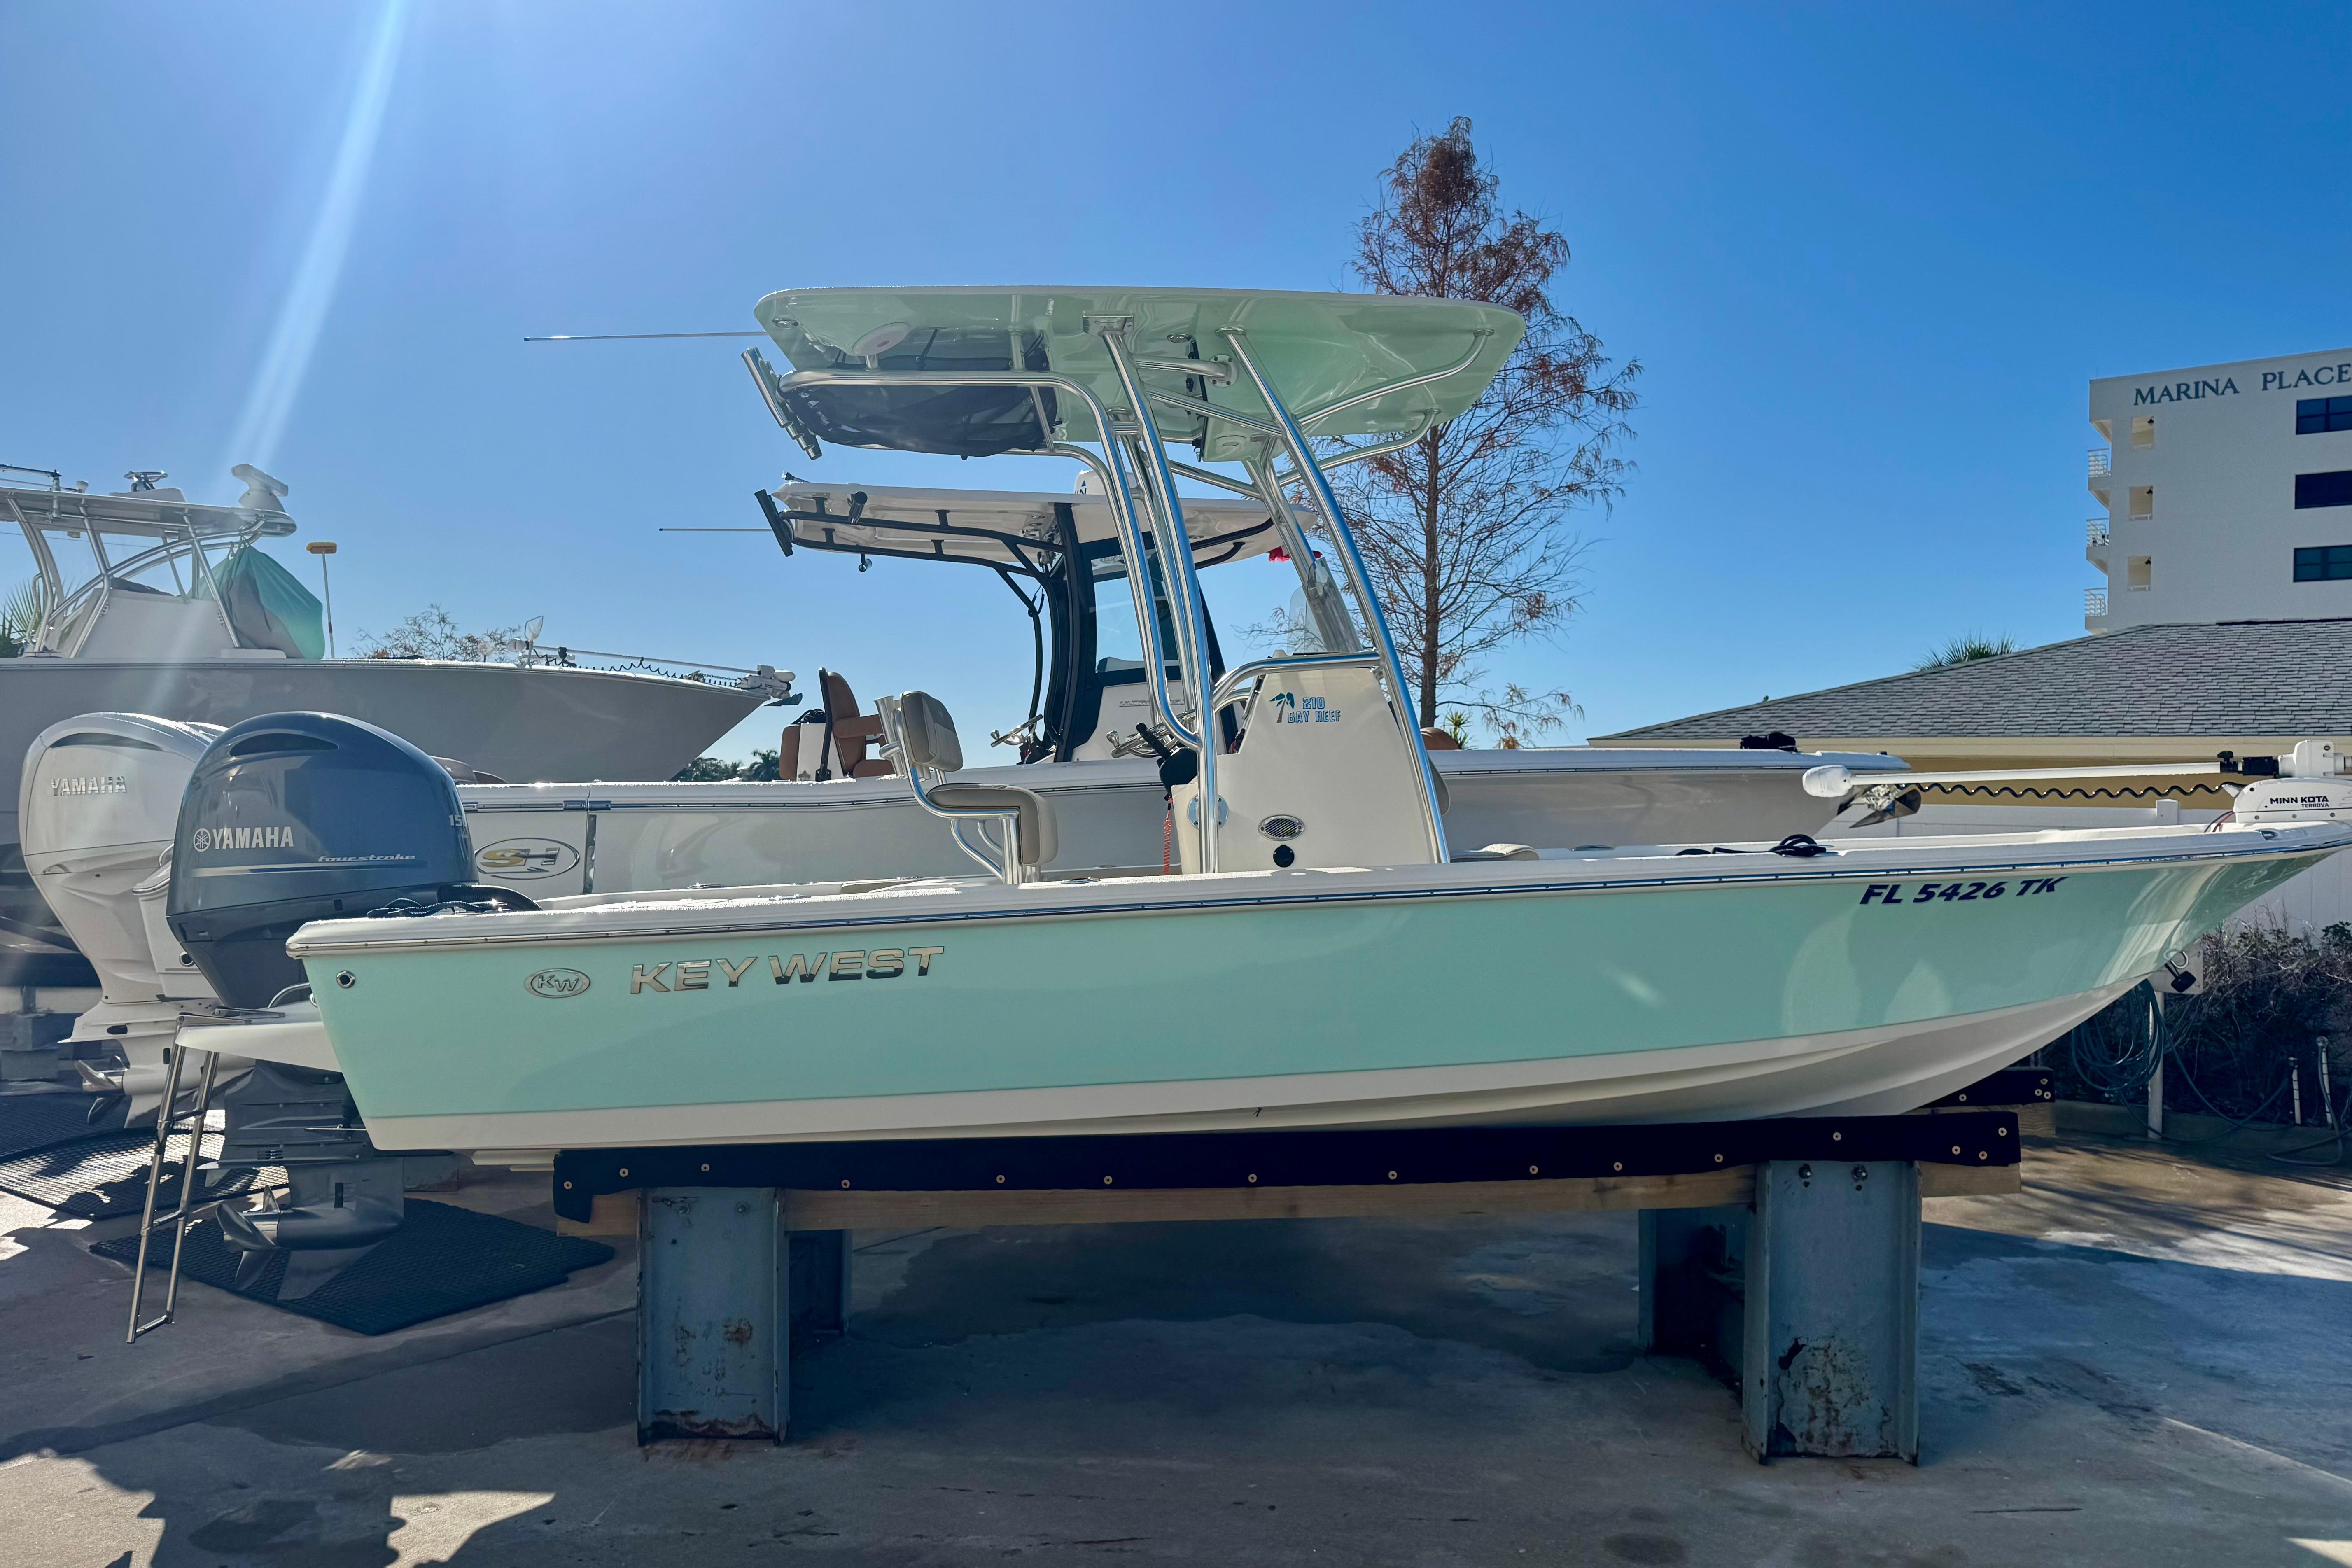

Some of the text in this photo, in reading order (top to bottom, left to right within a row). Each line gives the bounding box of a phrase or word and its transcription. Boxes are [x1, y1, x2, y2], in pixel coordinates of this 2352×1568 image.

[2133, 364, 2351, 406] MARINA PLACE
[1303, 697, 1325, 709] 210
[1288, 710, 1341, 723] BAY REEF
[51, 776, 127, 796] YAMAHA
[212, 826, 294, 849] YAMAHA
[1859, 877, 2069, 904] FL 5426 TK
[631, 946, 944, 994] KEY WEST
